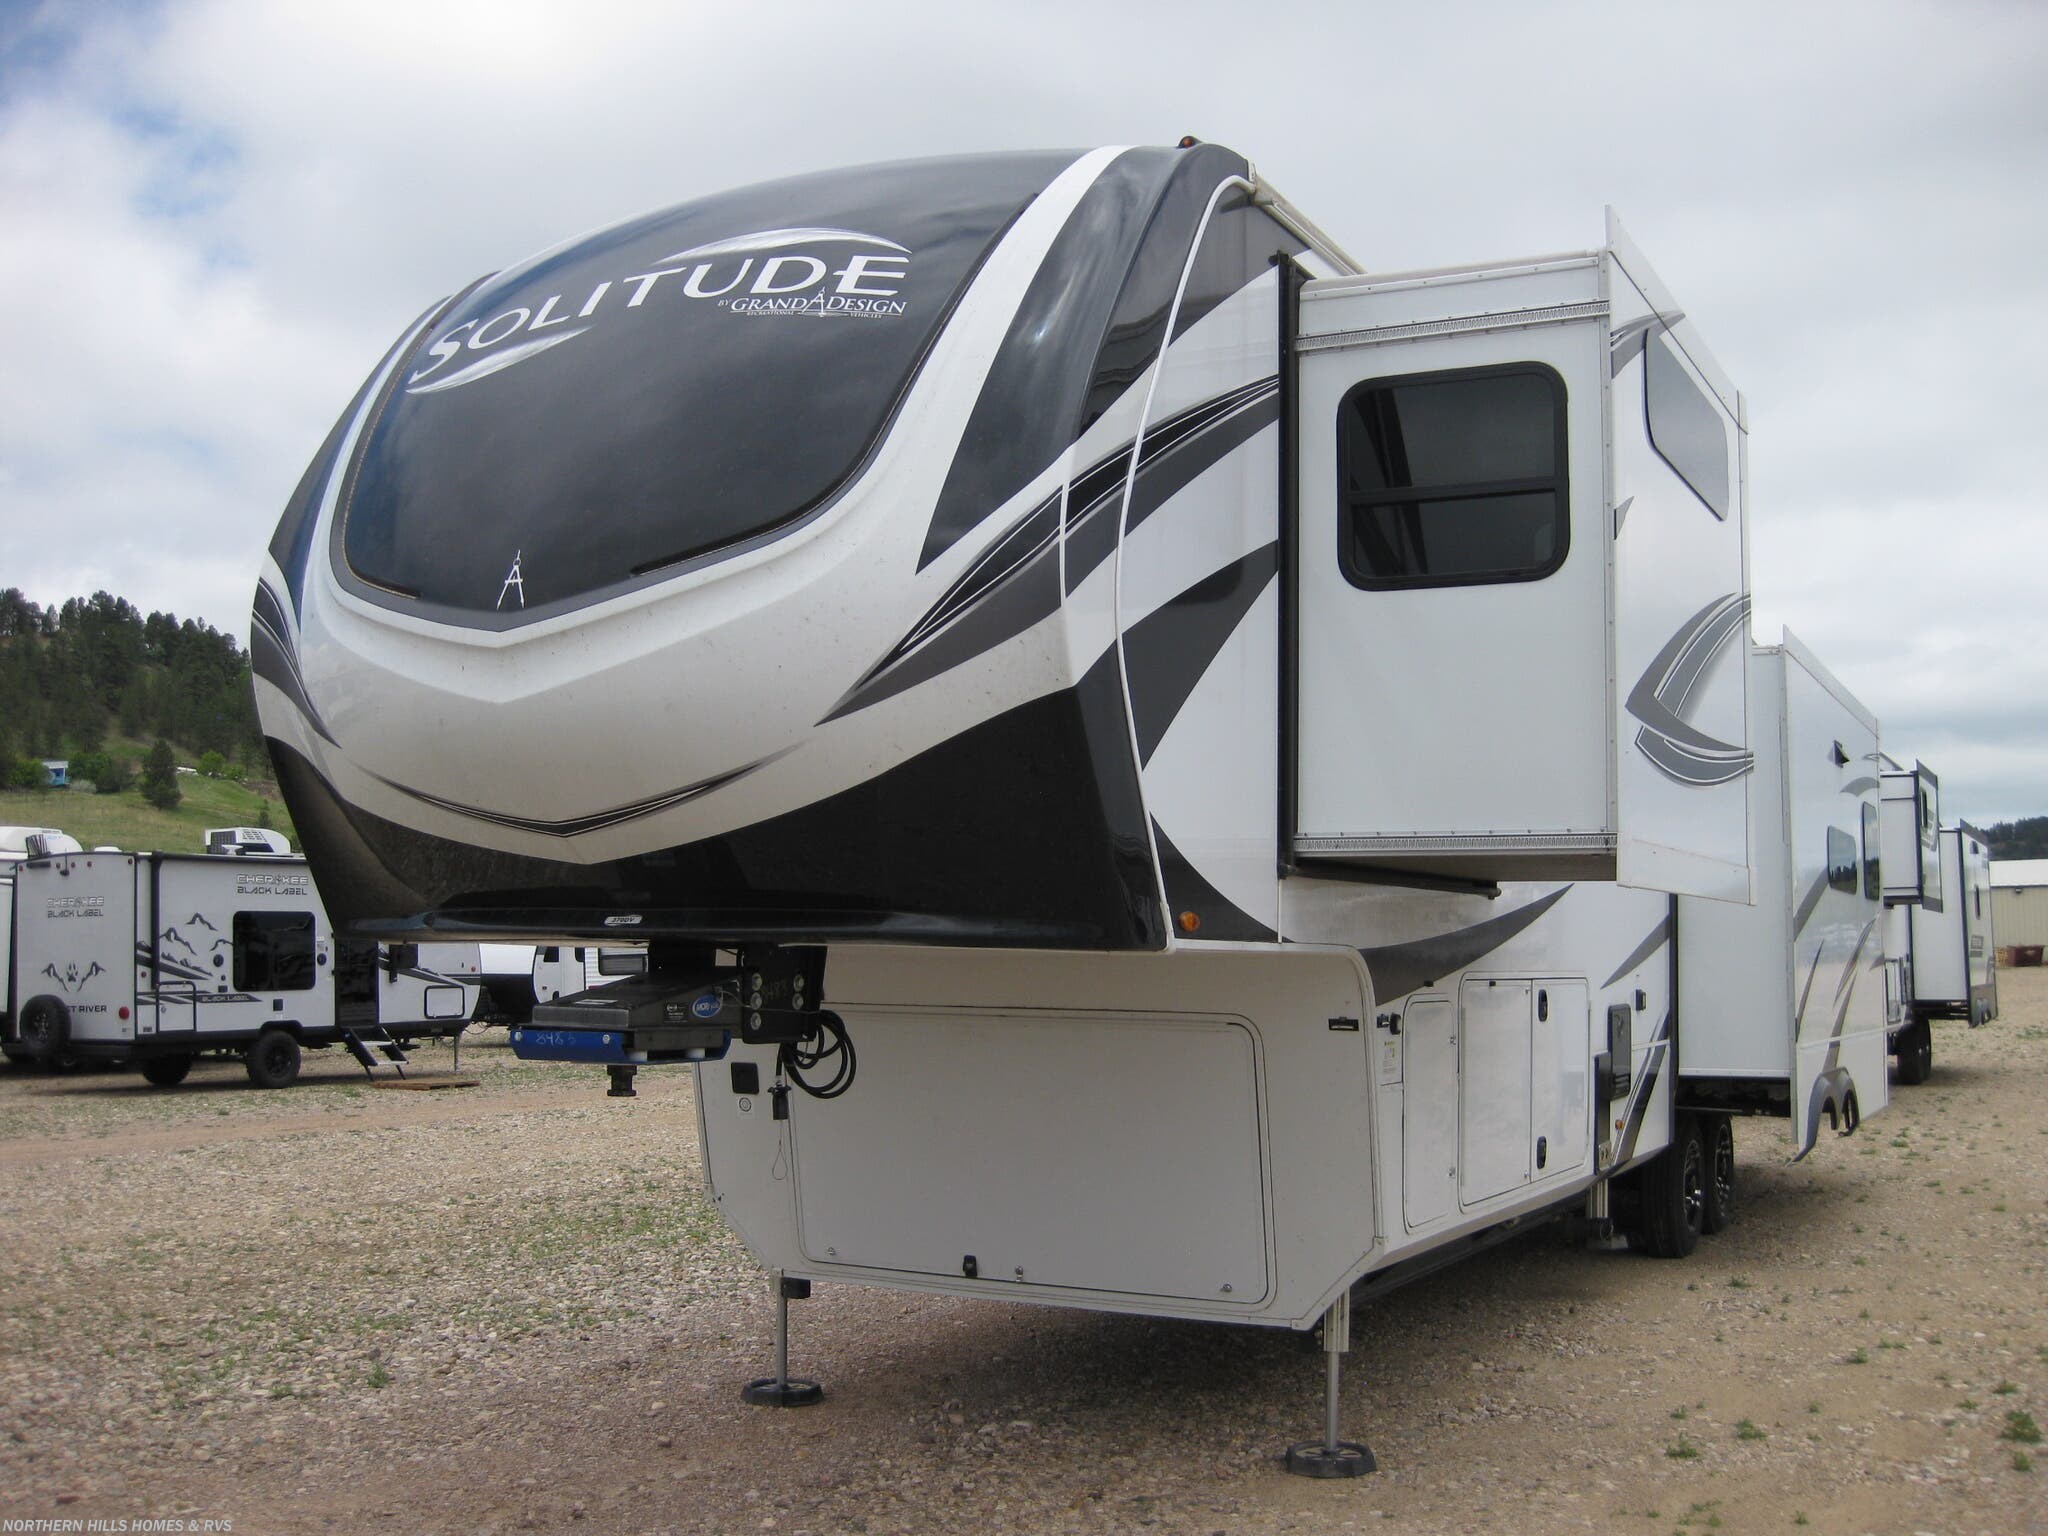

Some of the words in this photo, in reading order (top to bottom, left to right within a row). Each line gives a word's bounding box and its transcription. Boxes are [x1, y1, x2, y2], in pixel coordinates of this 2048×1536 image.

[730, 296, 808, 312] GRAND
[826, 296, 907, 315] DESIGN
[408, 256, 910, 384] SOLITUDE
[237, 886, 272, 895] BLACK
[274, 887, 308, 896] LABEL
[79, 1004, 108, 1013] RIVER
